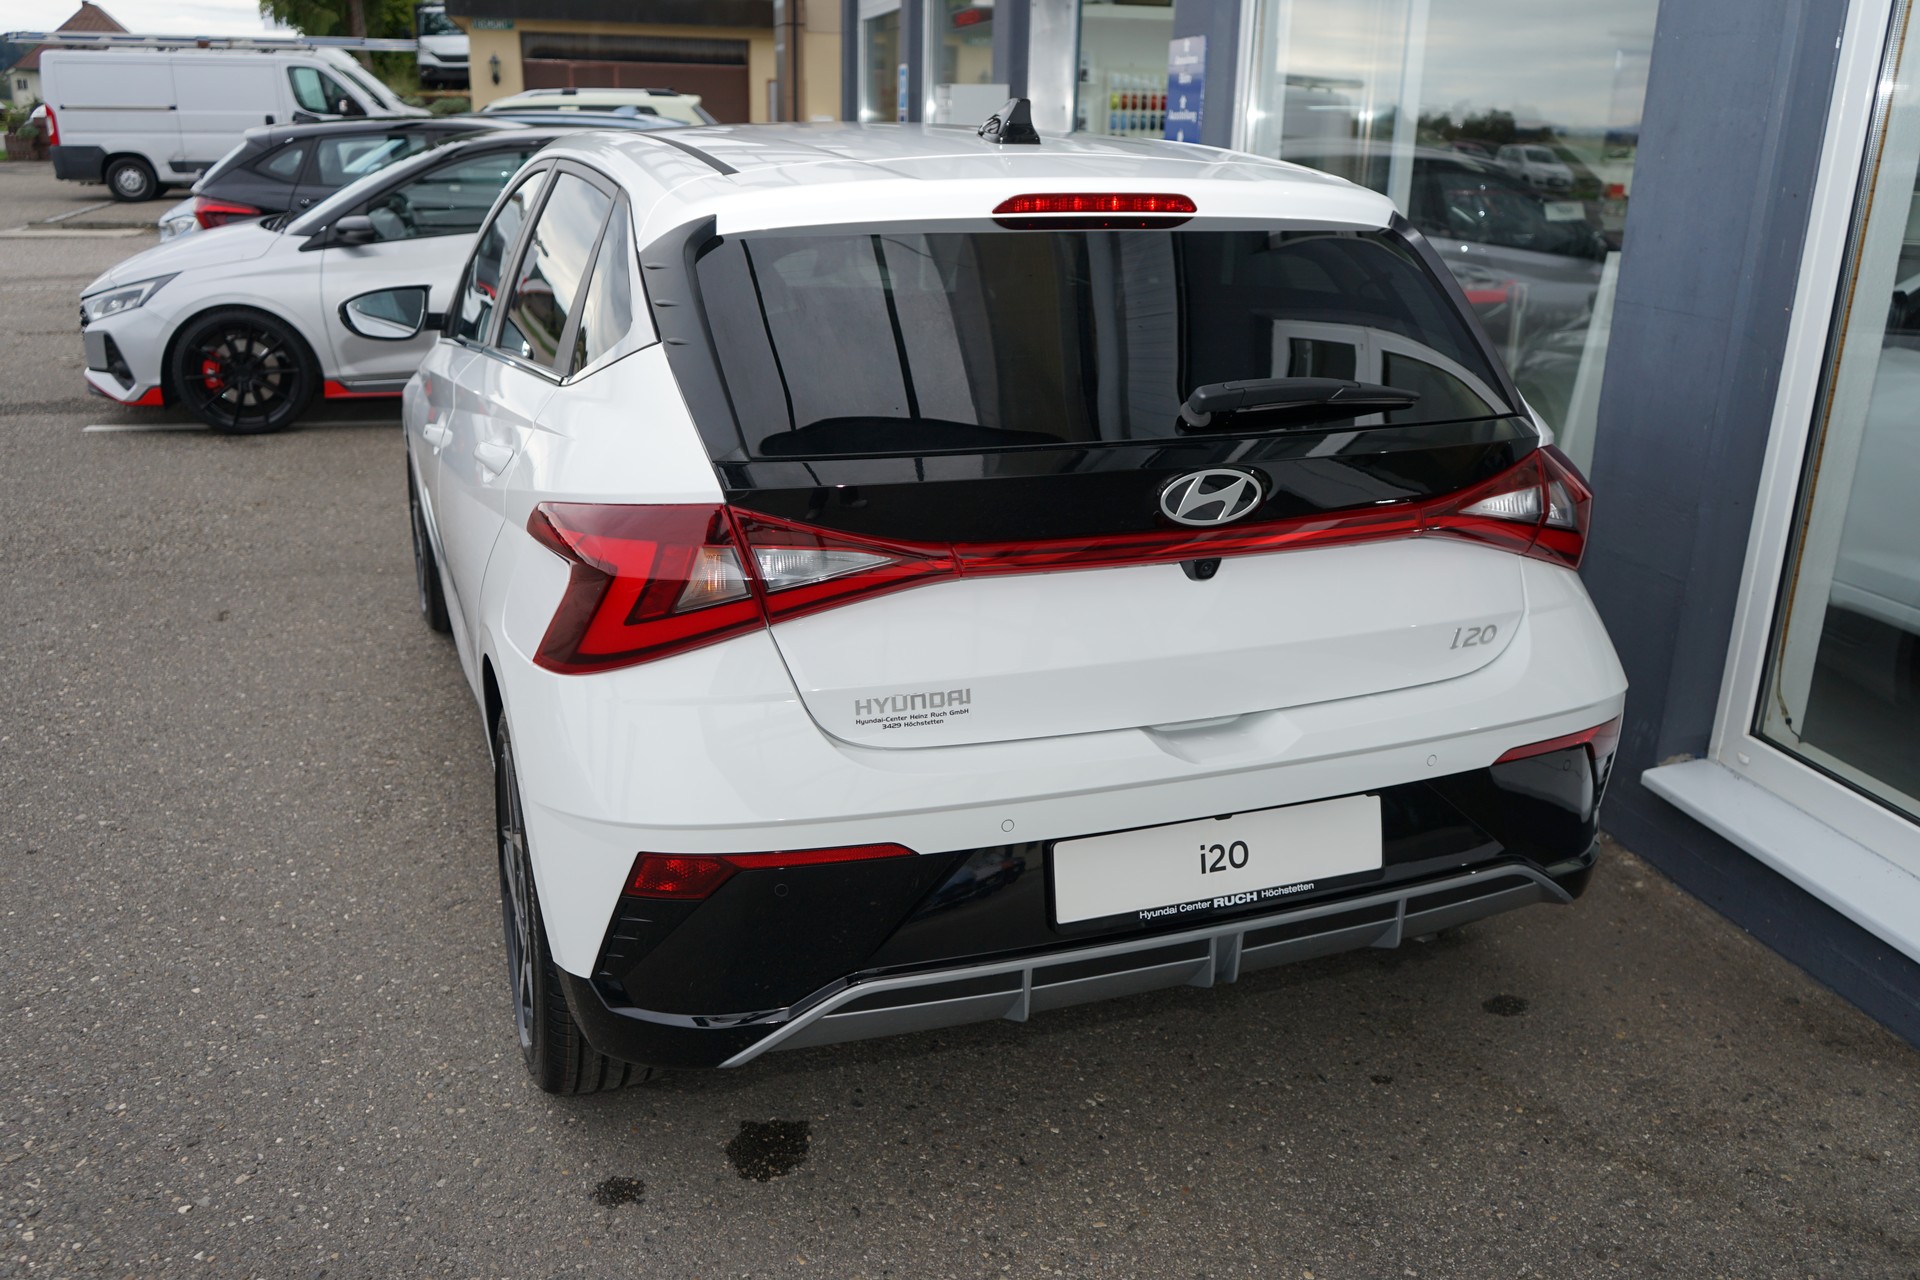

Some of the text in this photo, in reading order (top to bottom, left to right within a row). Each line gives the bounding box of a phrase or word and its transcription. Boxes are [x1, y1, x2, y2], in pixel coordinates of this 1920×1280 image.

[855, 688, 971, 716] HYUNDAI
[855, 715, 907, 726] Hyundai-Center
[930, 711, 947, 719] Ruch
[949, 708, 969, 716] GmbH
[882, 718, 944, 730] 3429 Höchstetten
[1199, 840, 1250, 875] i20
[1139, 881, 1315, 920] Hyundai Center RUCH Höchstetten
